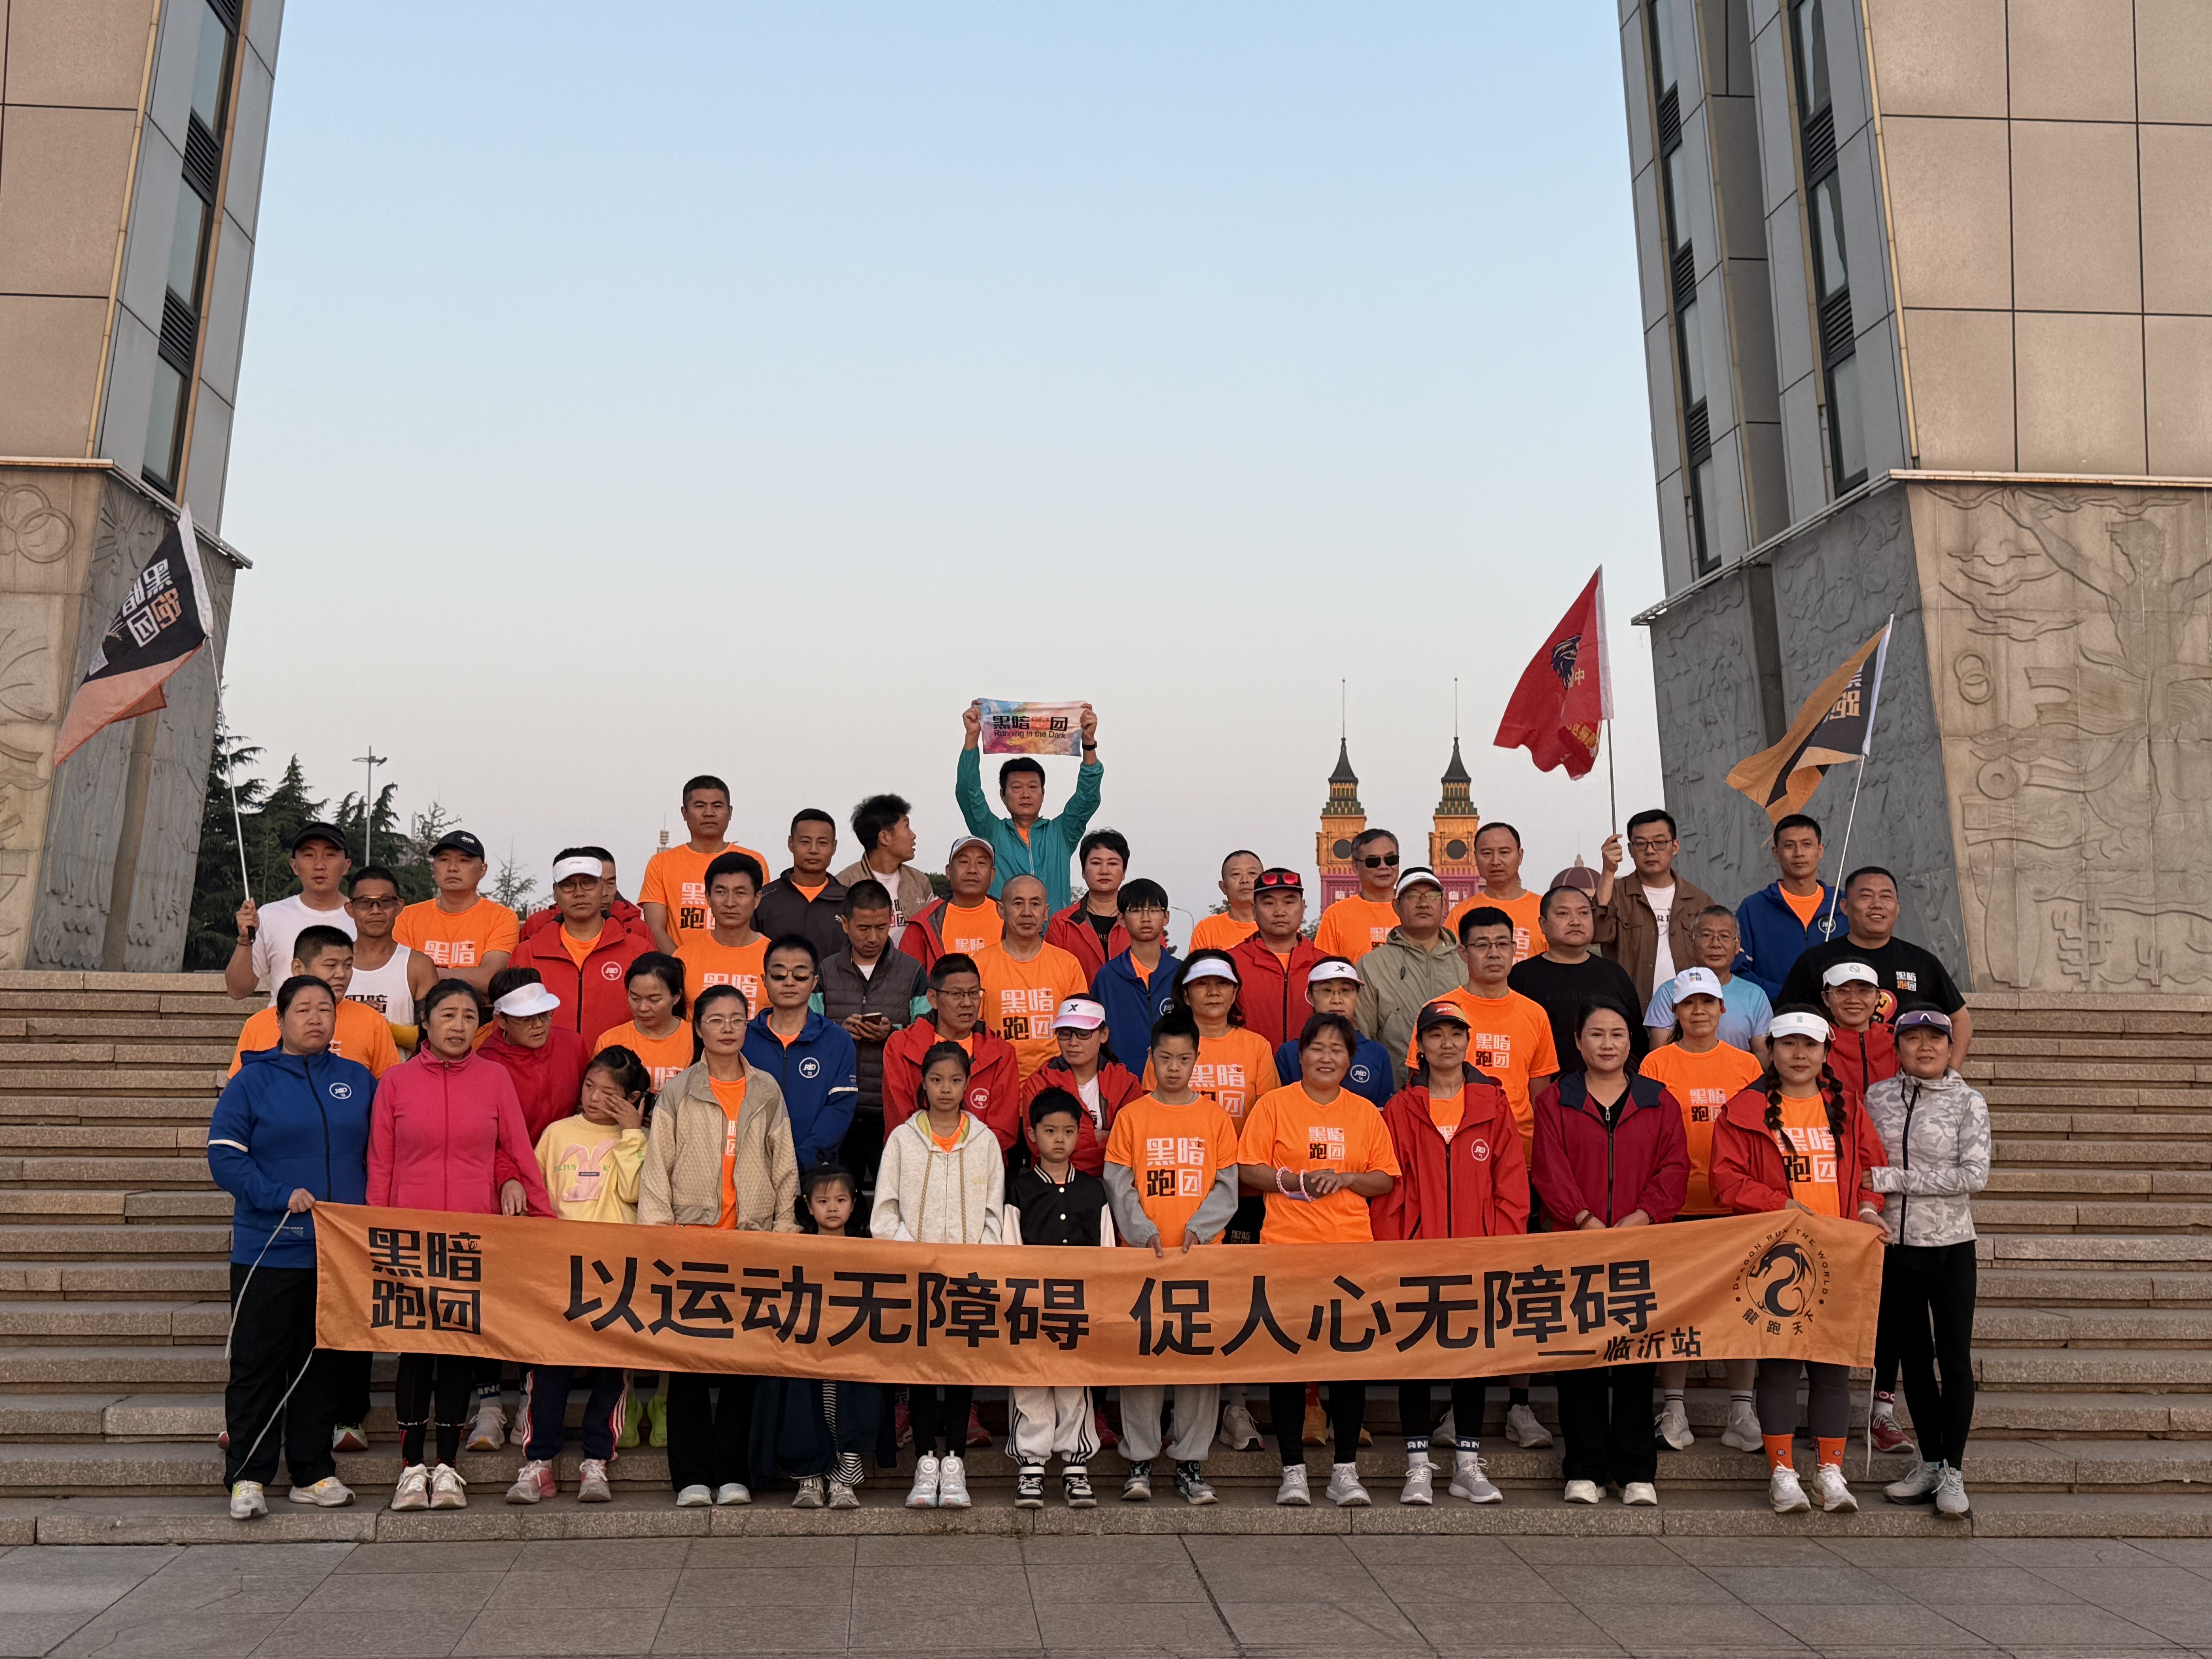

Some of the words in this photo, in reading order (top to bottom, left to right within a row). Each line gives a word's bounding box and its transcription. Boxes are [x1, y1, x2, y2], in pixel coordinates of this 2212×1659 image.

[994, 730, 1024, 738] Running
[1048, 731, 1066, 739] Dark
[1370, 927, 1393, 941] 黑
[424, 940, 476, 965] 黑暗
[1001, 988, 1054, 1015] 黑暗
[1002, 1015, 1054, 1040] 跑团
[1476, 1033, 1511, 1051] 黑暗
[1475, 1051, 1510, 1068] 跑团
[1187, 1064, 1245, 1088] 黑暗
[1194, 1090, 1245, 1118] 团
[1690, 1088, 1726, 1104] 黑暗
[1309, 1126, 1345, 1142] 黑暗
[1146, 1137, 1206, 1166] 黑暗
[1309, 1142, 1345, 1161] 跑团
[1782, 1154, 1838, 1183] 跑团
[1146, 1168, 1203, 1197] 跑团
[369, 1227, 482, 1282] 黑暗
[1766, 1228, 1789, 1241] RUN
[1795, 1228, 1816, 1246] THE
[1817, 1250, 1830, 1295] WORLD
[371, 1279, 481, 1335] 跑团
[563, 1255, 1090, 1350] 以运动无障碍
[1129, 1259, 1658, 1356] 促人心无障碍
